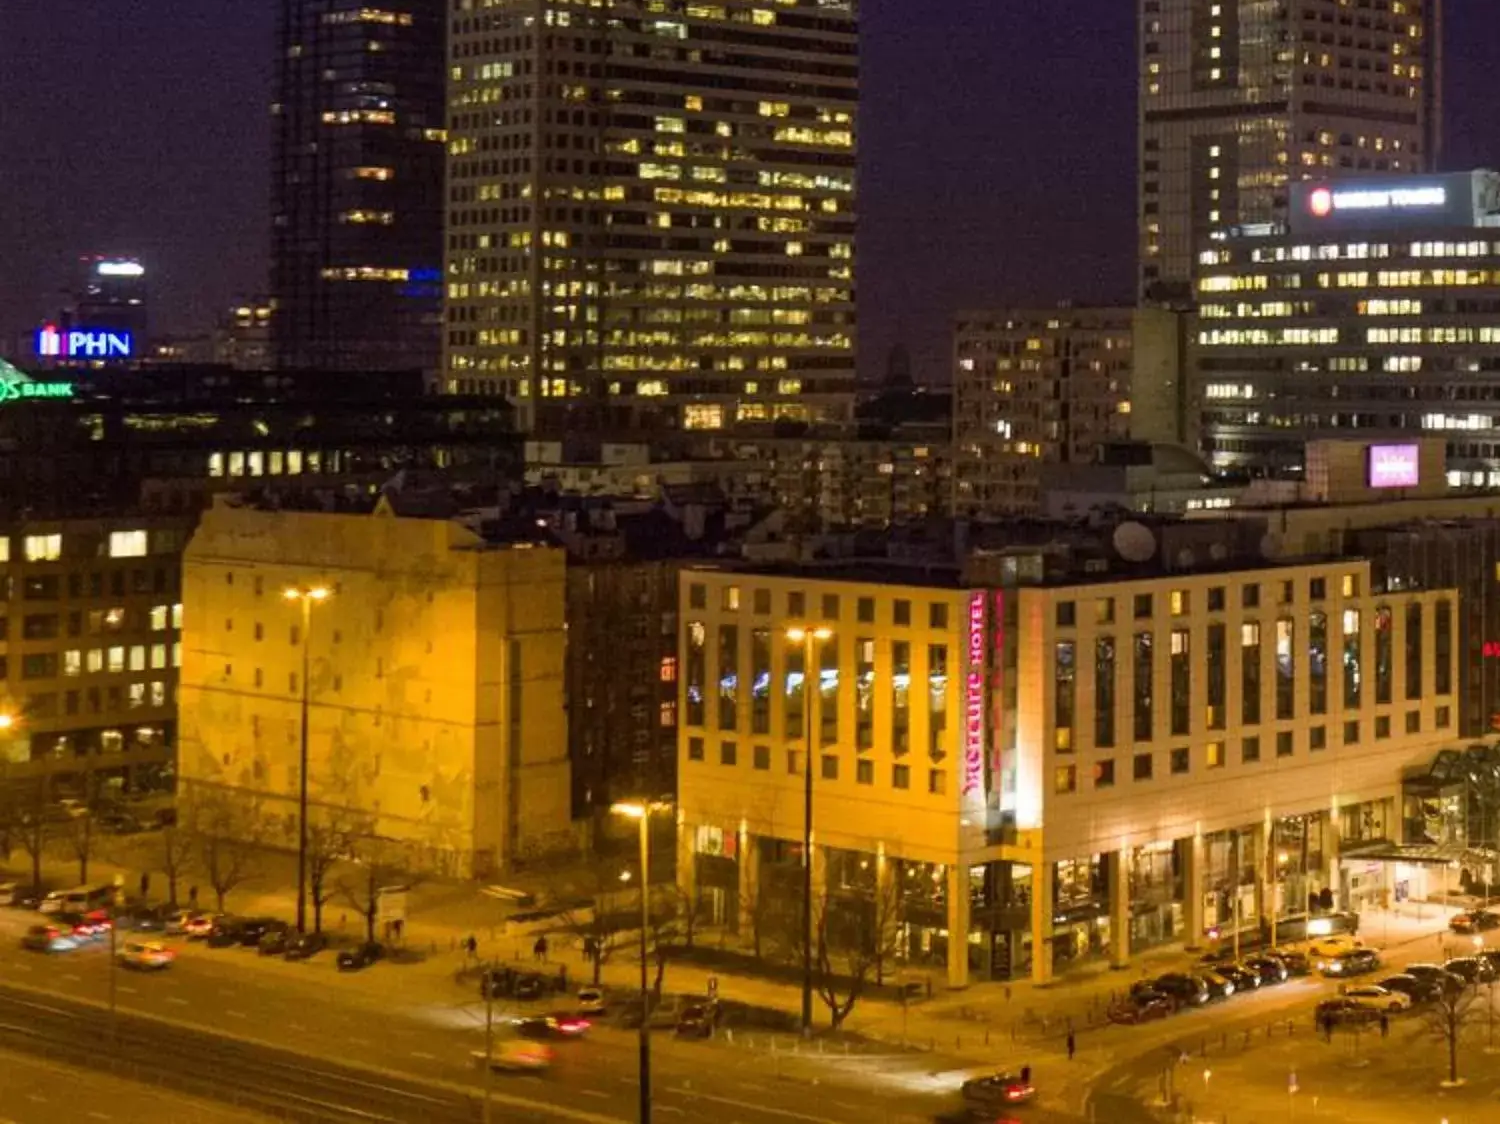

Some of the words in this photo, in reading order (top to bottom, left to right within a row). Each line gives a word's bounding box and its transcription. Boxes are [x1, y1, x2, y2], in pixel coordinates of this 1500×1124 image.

[69, 331, 130, 355] PHN
[22, 383, 73, 396] BANK
[970, 593, 984, 664] HOTEL
